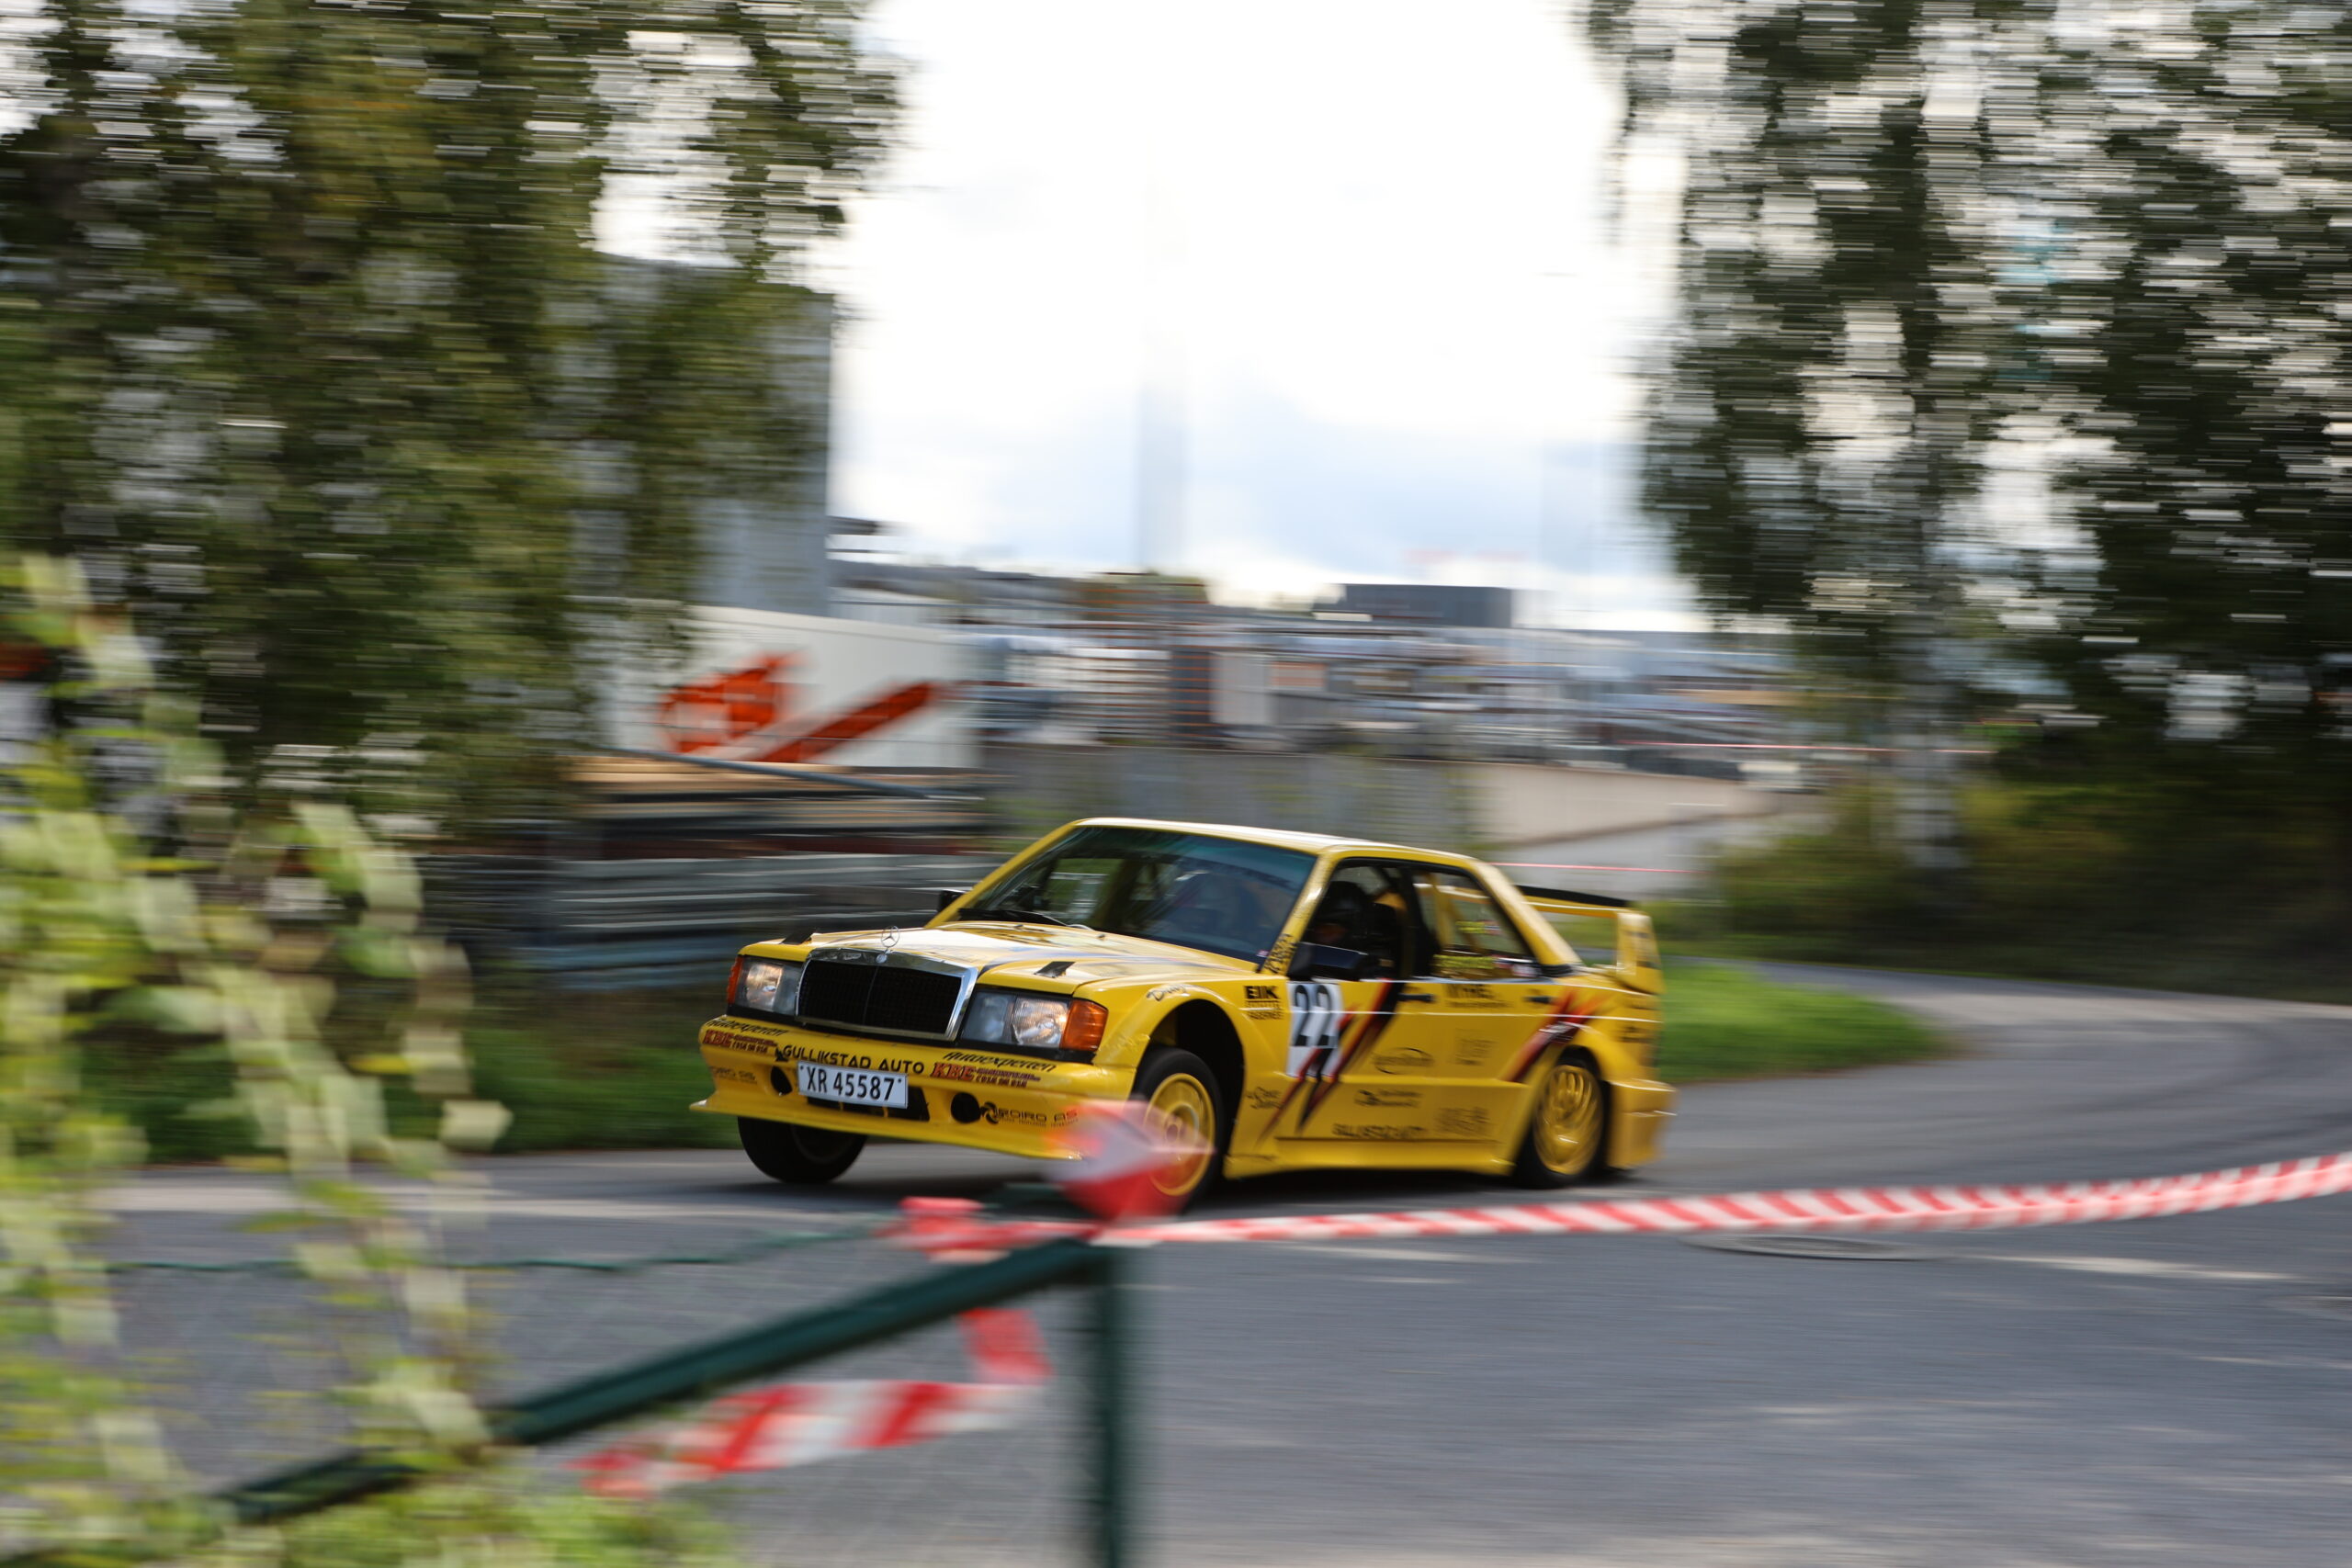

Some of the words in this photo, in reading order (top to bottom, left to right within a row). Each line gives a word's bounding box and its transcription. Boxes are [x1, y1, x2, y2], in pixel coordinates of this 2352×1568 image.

[1293, 984, 1338, 1047] 22
[782, 1044, 871, 1069] GULLIKSTAD
[878, 1058, 925, 1074] AUTO
[930, 1062, 977, 1082] KBE
[943, 1051, 1057, 1073] Autoexperten
[807, 1066, 827, 1093] XR
[833, 1070, 894, 1100] 45587
